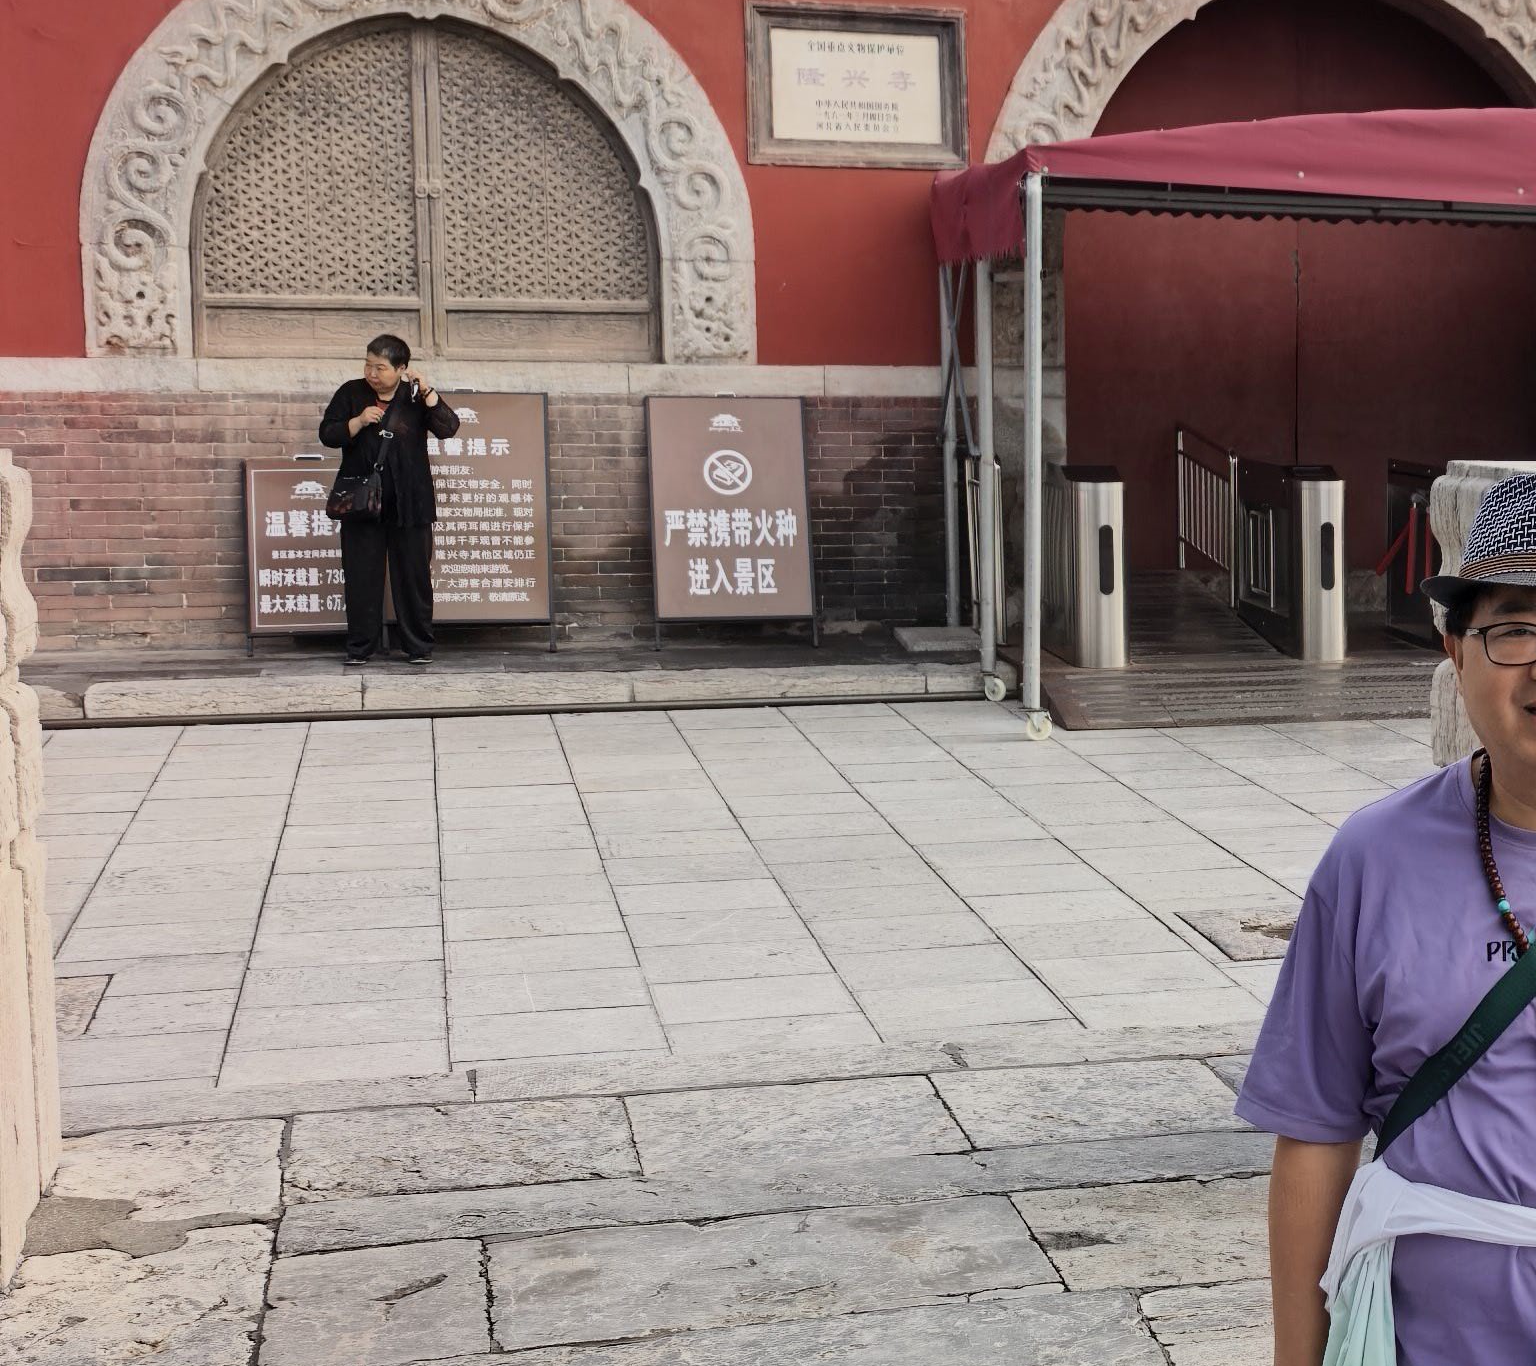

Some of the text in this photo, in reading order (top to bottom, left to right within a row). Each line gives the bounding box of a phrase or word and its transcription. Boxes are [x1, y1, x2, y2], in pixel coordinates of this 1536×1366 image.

[664, 508, 798, 548] 严禁携带火种
[688, 557, 779, 596] 进入景区
